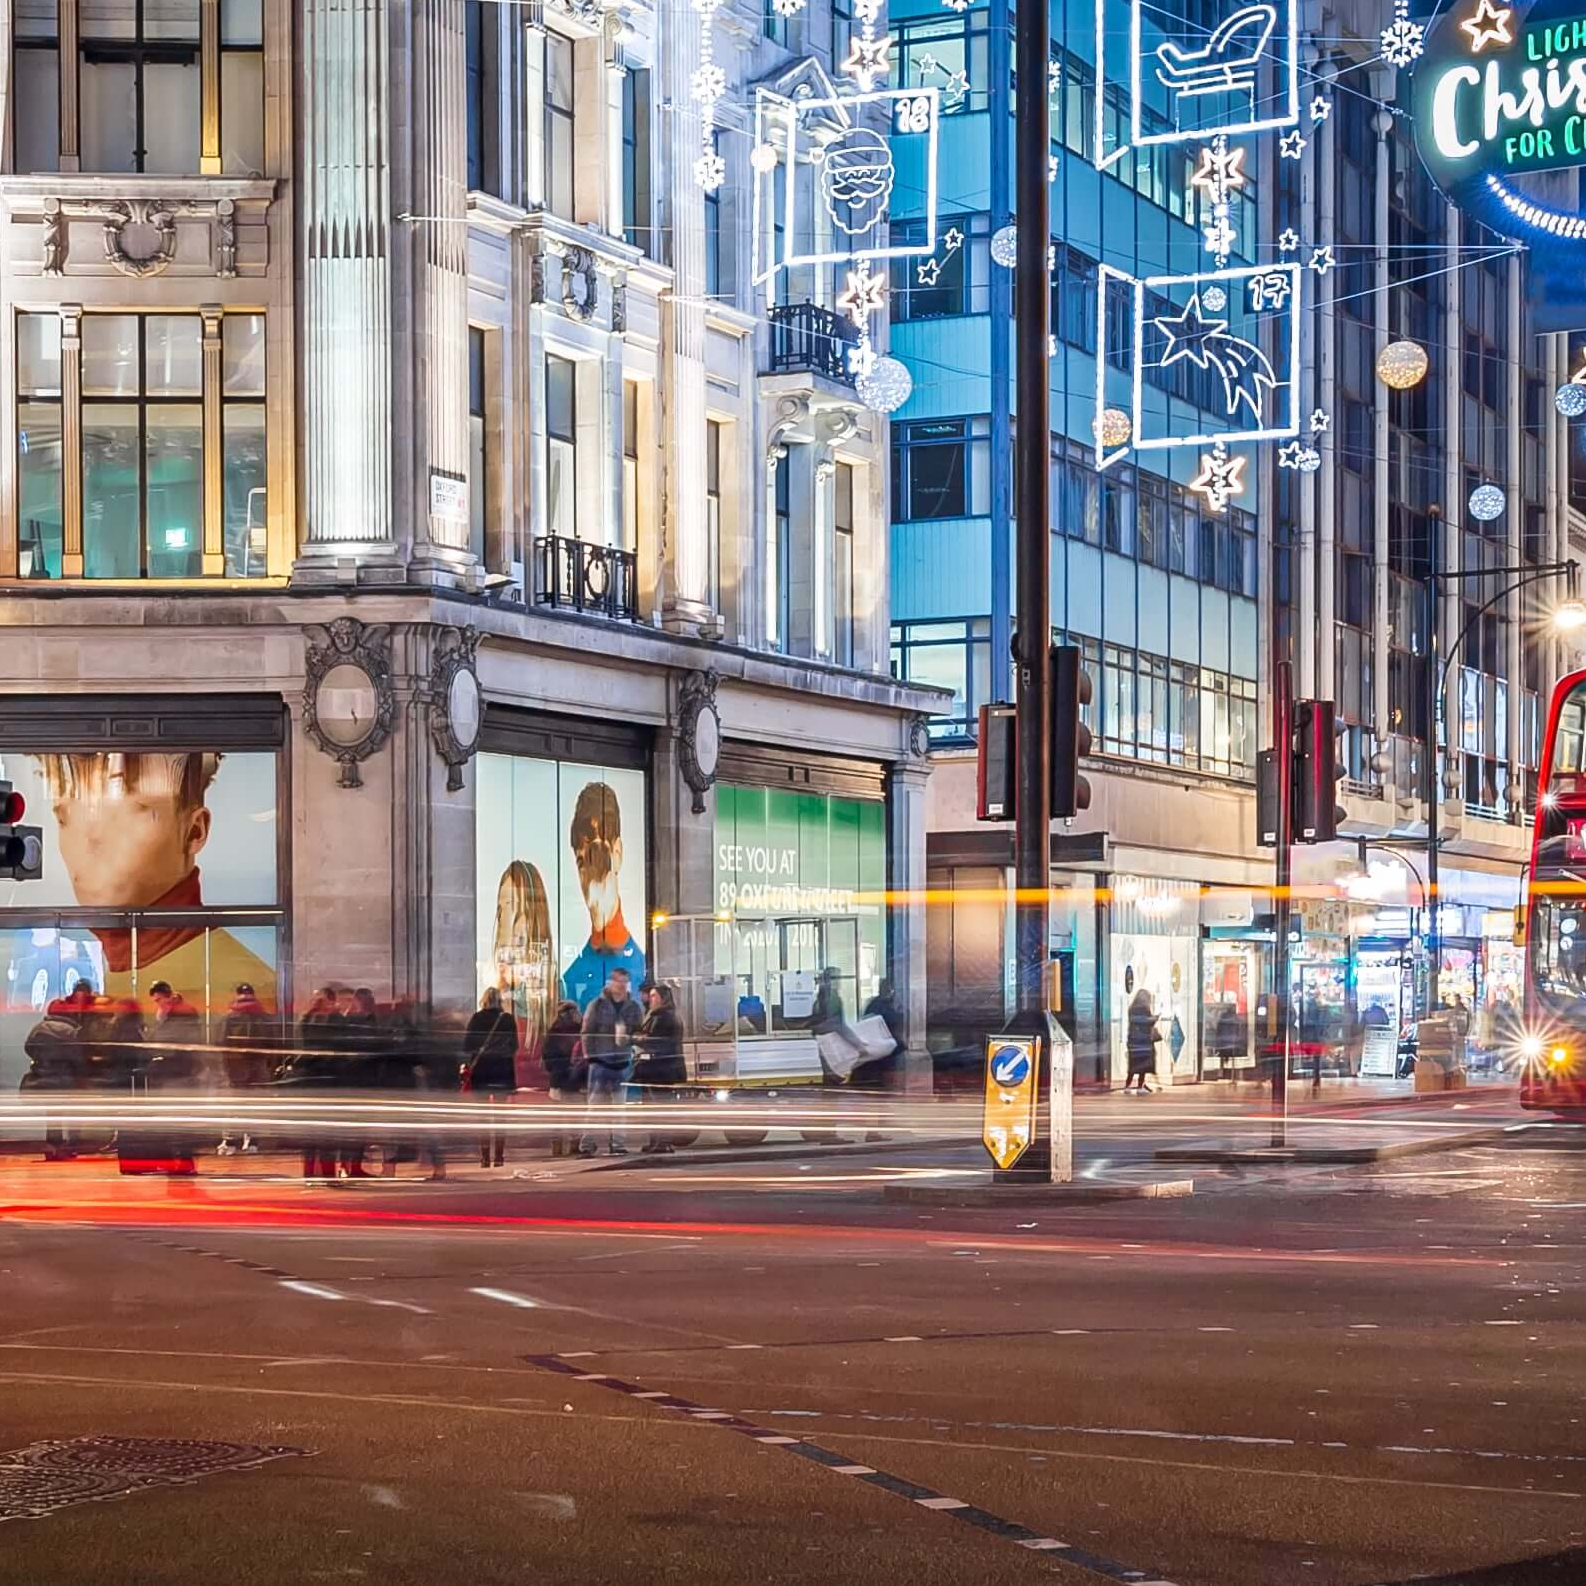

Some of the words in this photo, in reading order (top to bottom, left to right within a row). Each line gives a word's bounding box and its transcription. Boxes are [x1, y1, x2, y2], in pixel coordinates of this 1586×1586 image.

[895, 96, 930, 134] 18
[1505, 129, 1554, 164] FOR
[1247, 273, 1290, 311] 17
[718, 844, 743, 872] SEE
[745, 846, 777, 874] YOU
[779, 848, 797, 875] AT
[719, 881, 737, 908] 89
